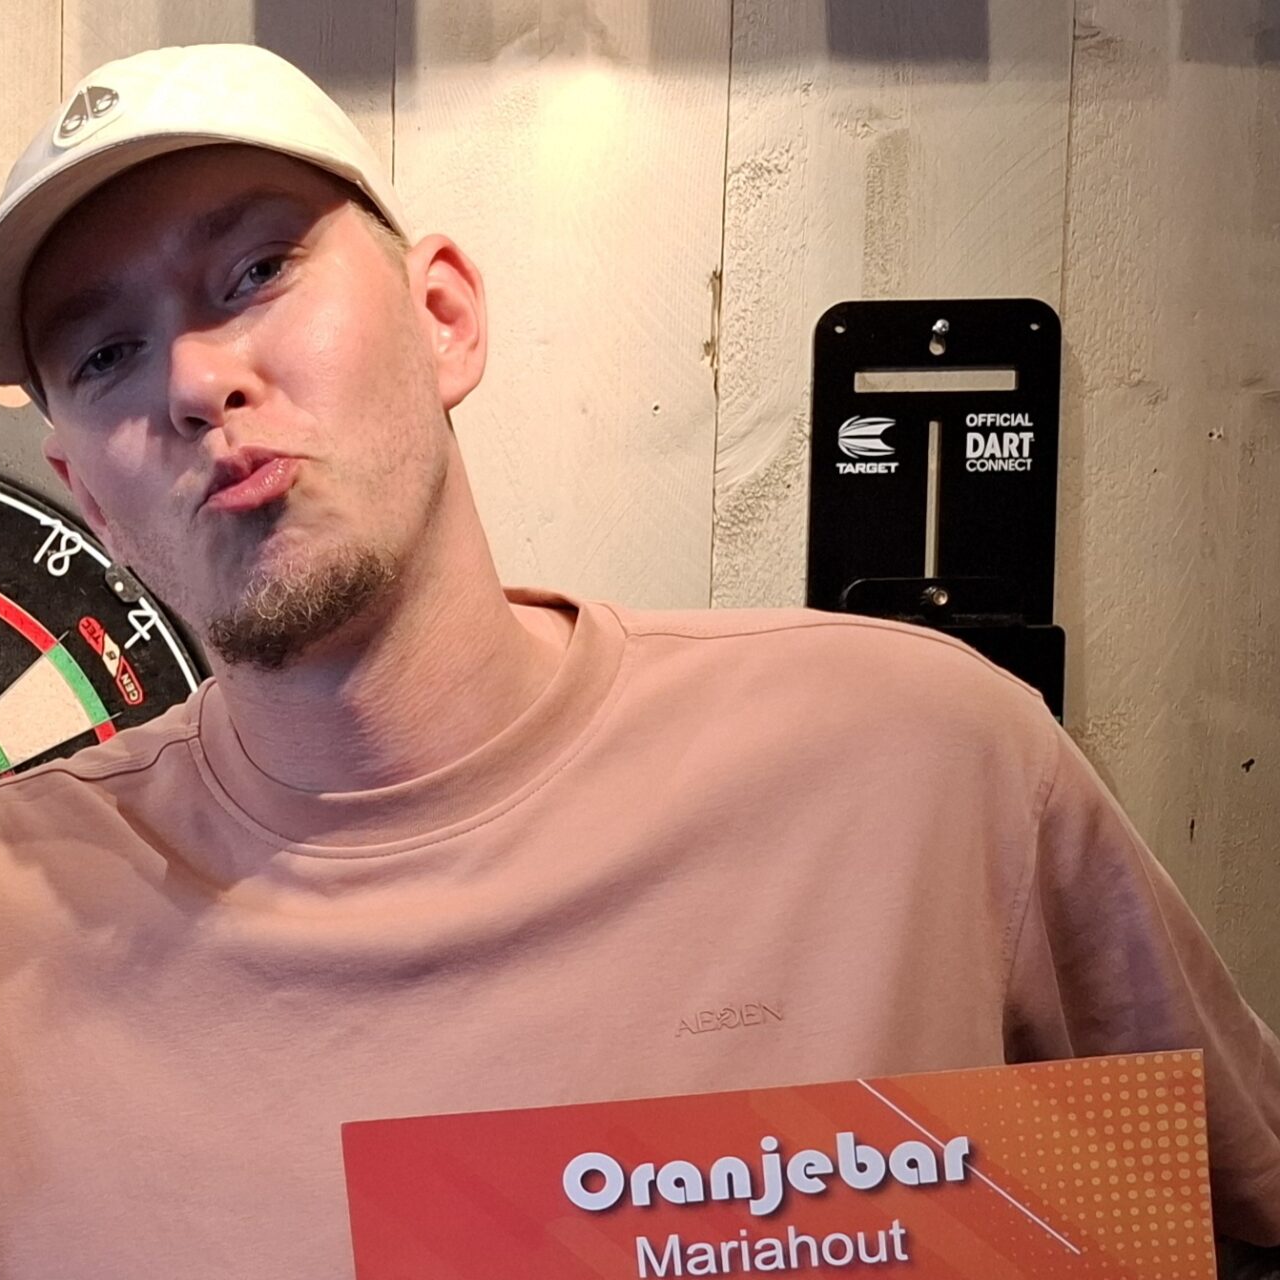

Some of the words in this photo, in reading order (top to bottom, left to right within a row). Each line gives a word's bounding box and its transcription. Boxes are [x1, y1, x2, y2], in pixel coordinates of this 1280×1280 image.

[966, 413, 1033, 427] OFFICIAL
[966, 432, 1033, 458] DART
[836, 462, 899, 474] TARGET
[966, 458, 1033, 472] CONNECT
[33, 519, 82, 577] 18
[80, 618, 101, 645] TEC
[124, 610, 158, 649] 4
[120, 673, 139, 701] GEN
[562, 1132, 970, 1215] Oranjebar
[635, 1219, 909, 1279] Mariahout
